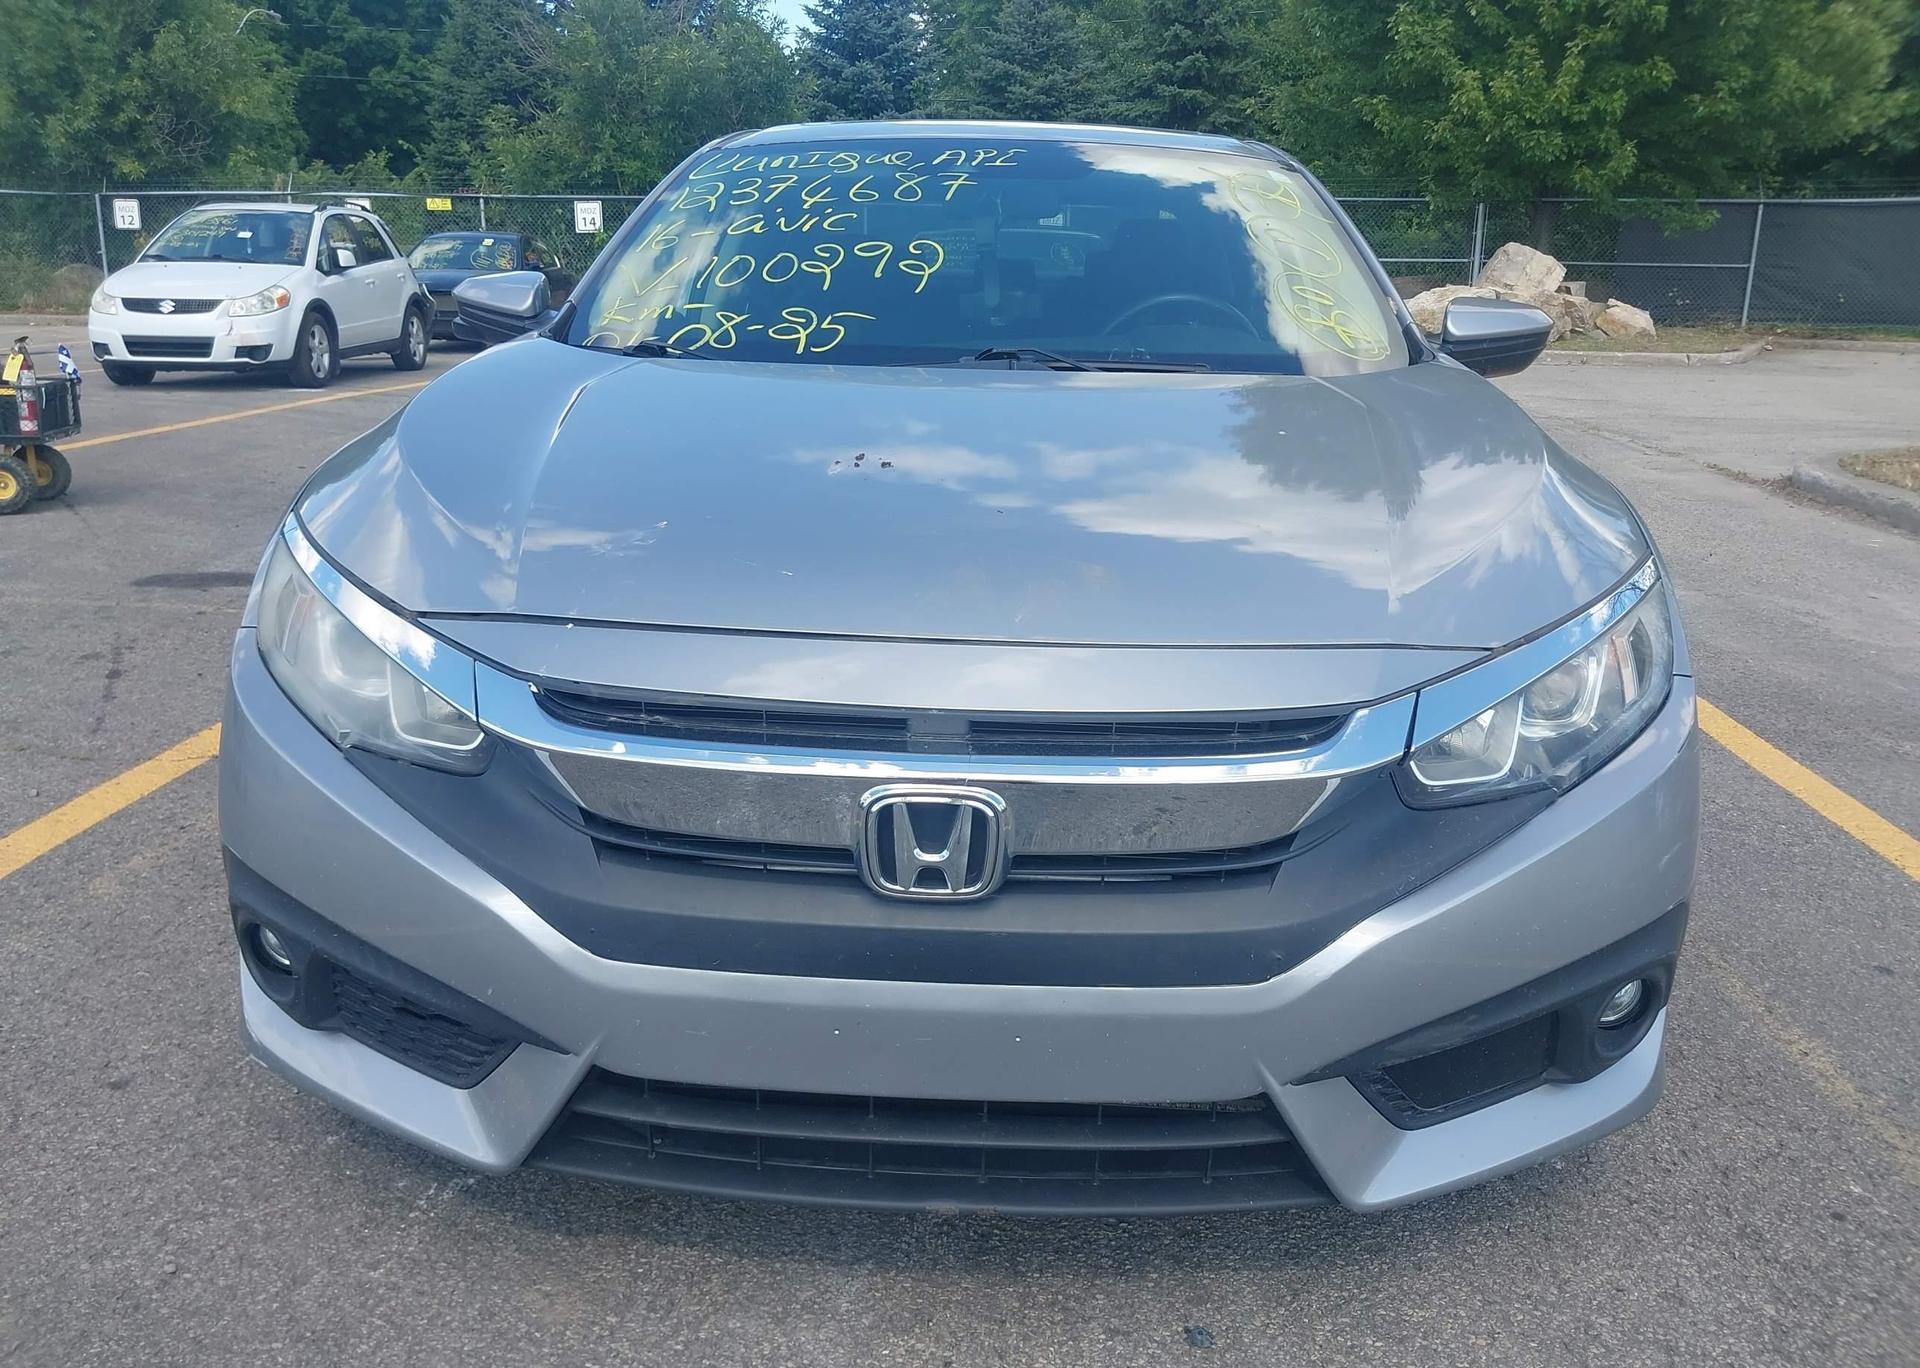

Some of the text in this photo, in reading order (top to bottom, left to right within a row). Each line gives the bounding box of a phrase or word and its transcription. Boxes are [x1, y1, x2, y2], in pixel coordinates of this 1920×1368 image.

[580, 207, 597, 215] MDZ
[120, 215, 136, 226] 12
[582, 217, 597, 228] 14
